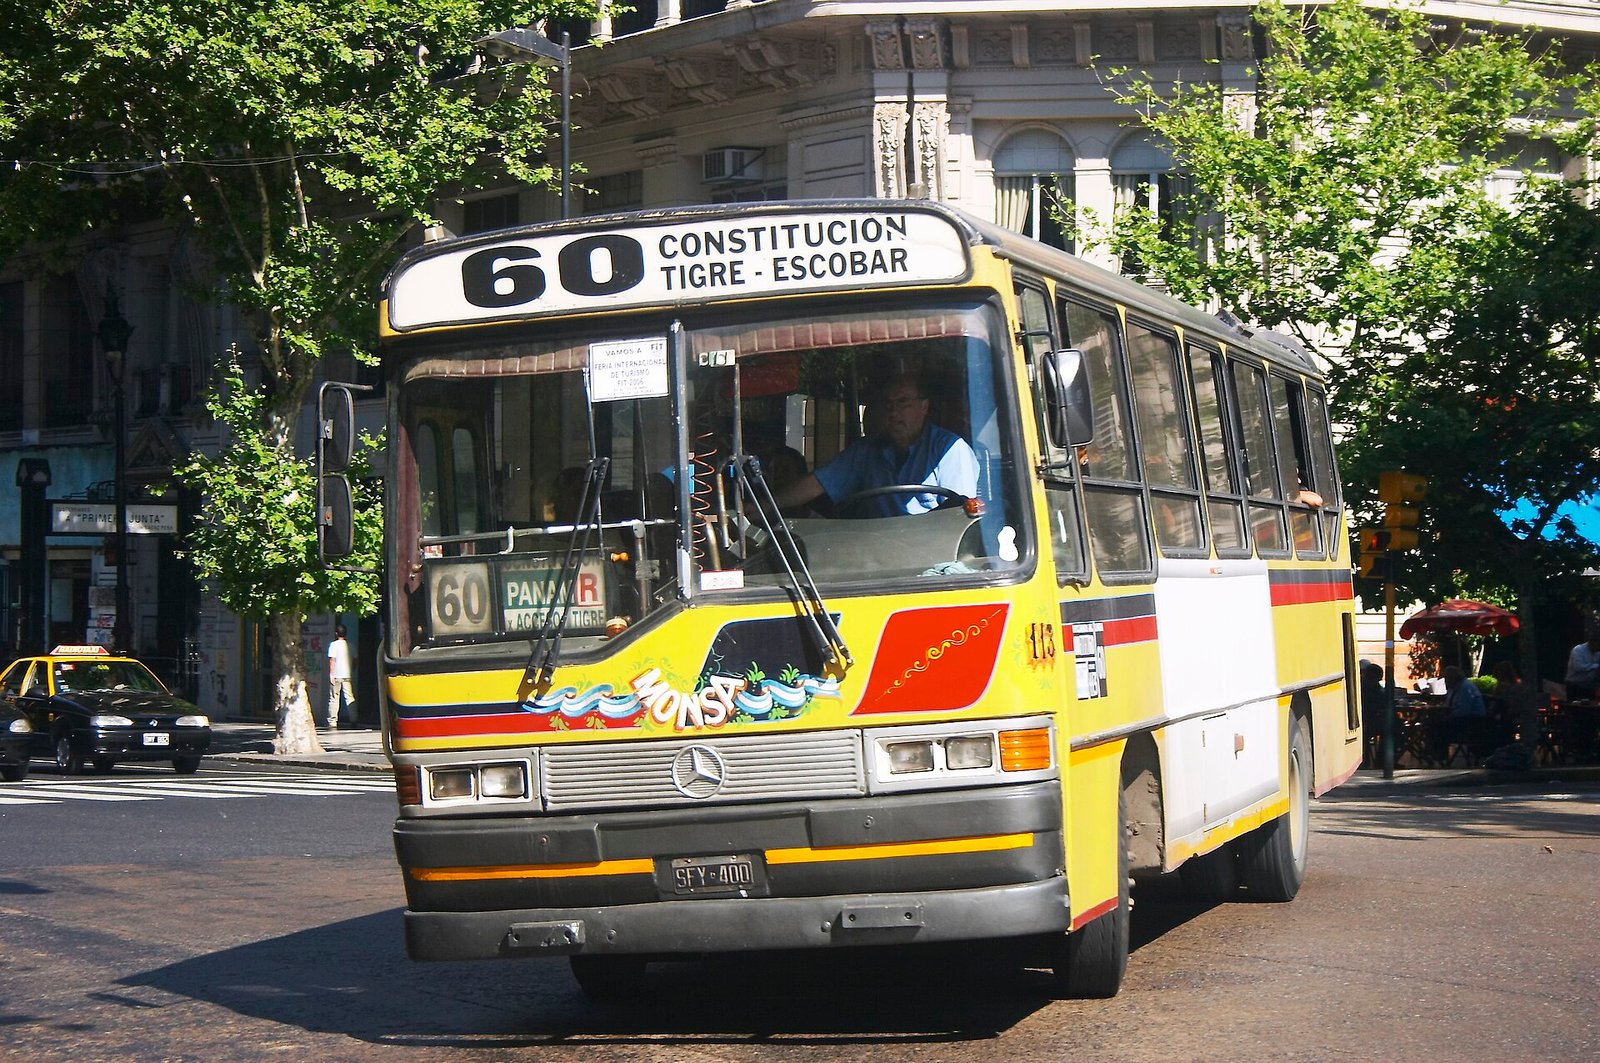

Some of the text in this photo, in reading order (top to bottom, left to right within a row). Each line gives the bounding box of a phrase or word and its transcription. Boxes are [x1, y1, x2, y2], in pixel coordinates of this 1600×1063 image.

[658, 215, 908, 259] CONSTITUCION
[462, 234, 646, 308] 60
[660, 260, 746, 291] TIGRE
[773, 247, 909, 282] ESCOBAR
[594, 362, 613, 371] FERIA
[605, 348, 634, 356] VAMOS
[436, 572, 488, 626] 60
[579, 573, 599, 602] R
[516, 611, 561, 630] ACCEO
[572, 610, 604, 628] TIGRE
[632, 667, 746, 731] MONSA
[719, 864, 750, 884] 400
